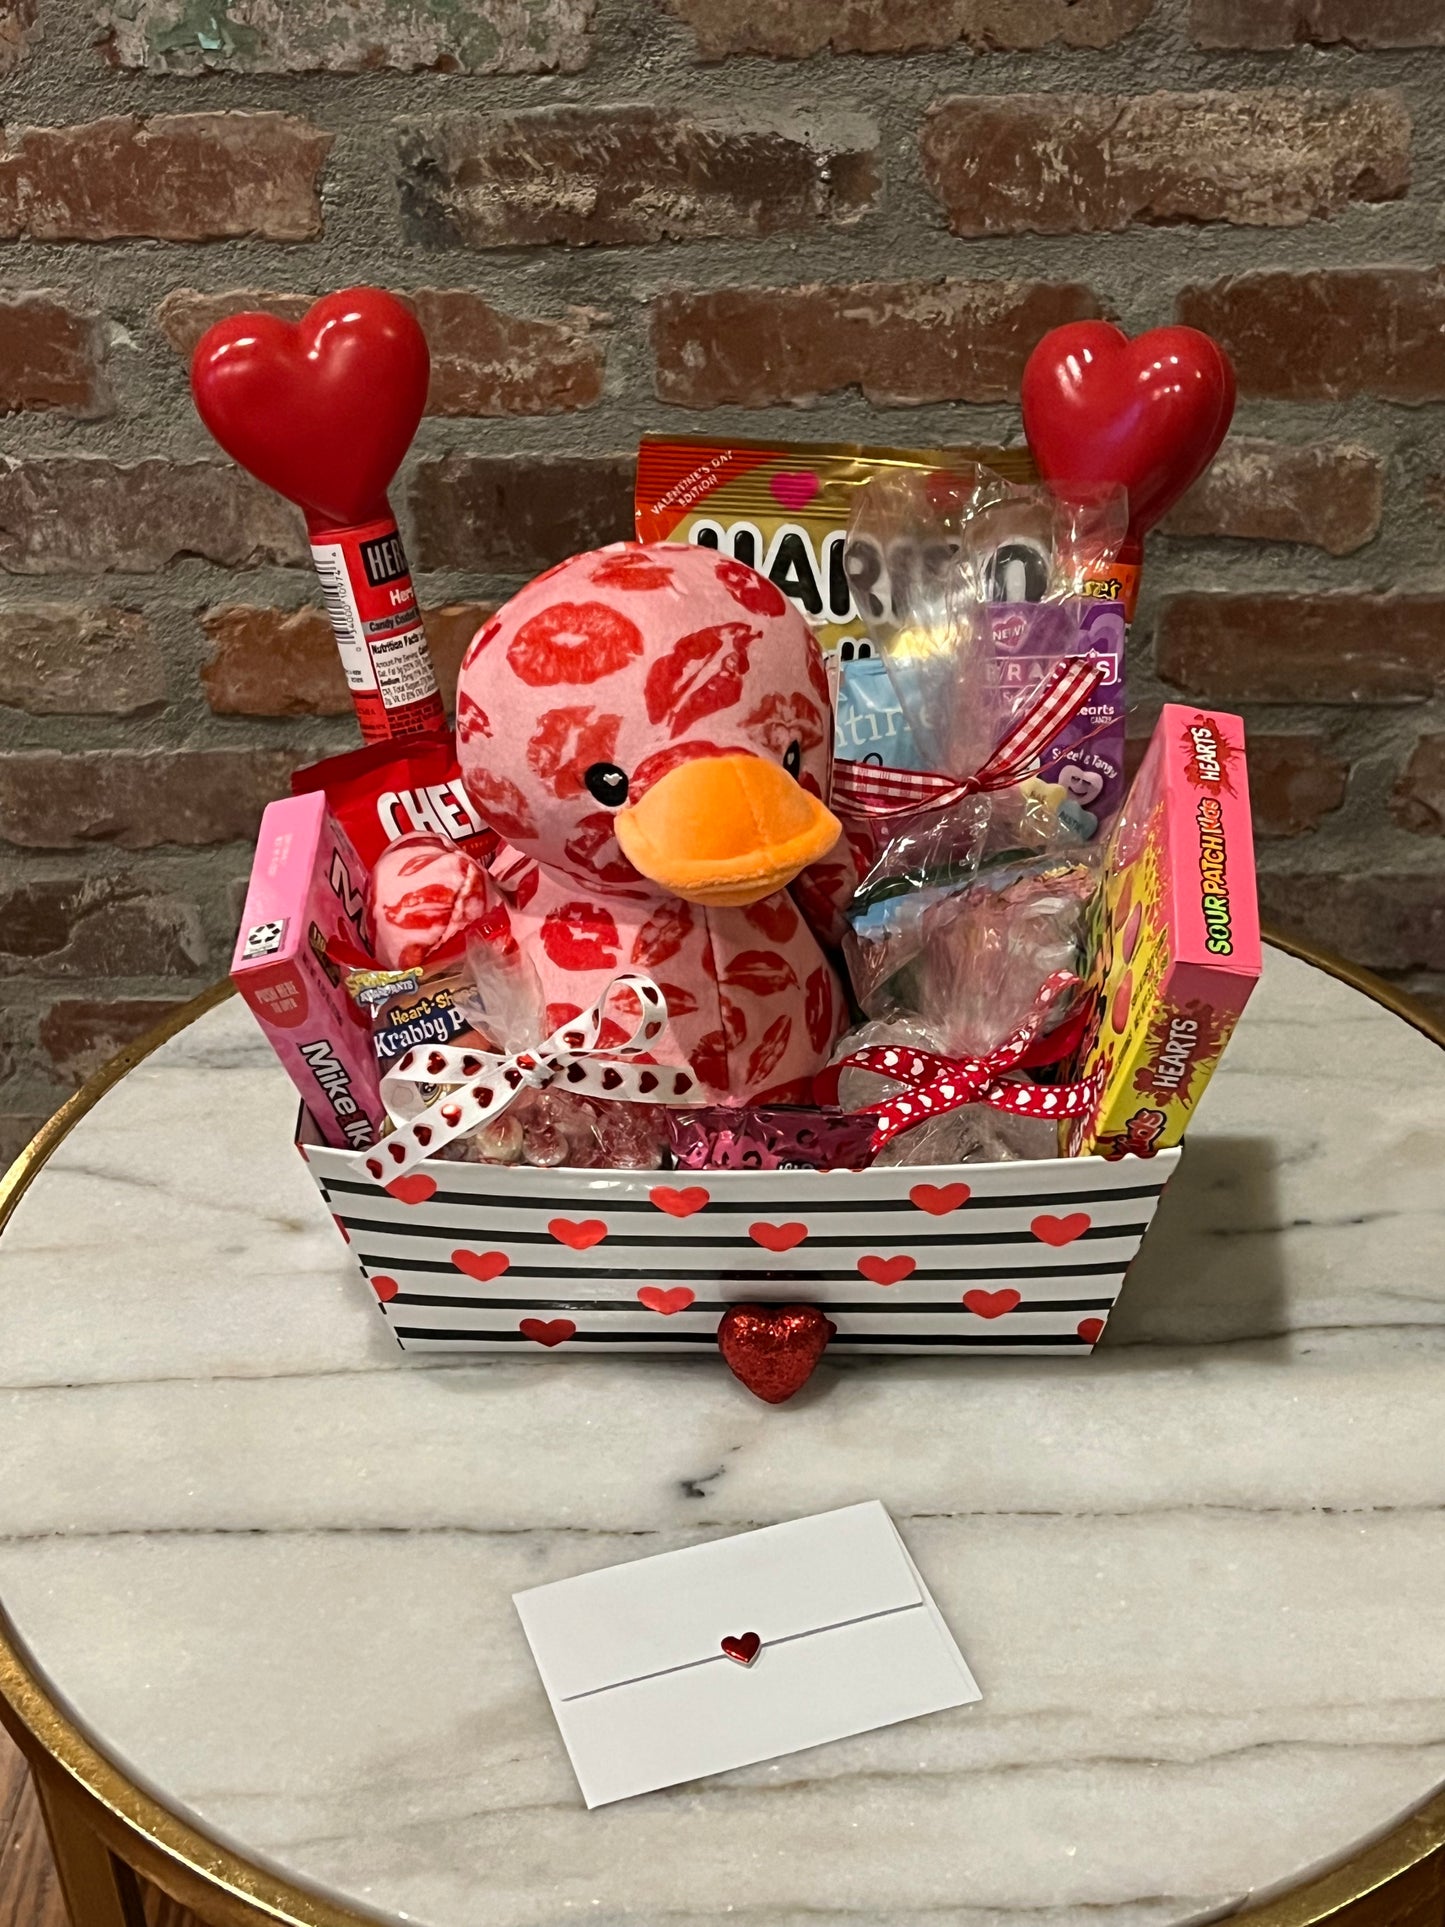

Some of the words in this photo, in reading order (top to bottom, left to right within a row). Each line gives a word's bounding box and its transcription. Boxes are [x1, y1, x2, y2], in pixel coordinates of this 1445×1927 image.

[650, 466, 711, 515] VALENTINE'S
[710, 450, 733, 468] DAY
[678, 474, 719, 507] EDITION
[367, 539, 406, 580] HER
[369, 618, 394, 632] Candy
[992, 625, 1025, 641] NEW!
[371, 640, 404, 655] Nutrition
[1077, 703, 1115, 717] earts
[1092, 754, 1118, 779] Tangy
[1190, 727, 1221, 781] HEARTS
[1197, 798, 1223, 836] Kids
[1200, 835, 1226, 896] PATCH
[1203, 895, 1232, 956] SOUR
[373, 1016, 449, 1058] Krabby
[1151, 1018, 1199, 1088] HEARTS
[301, 1040, 357, 1115] Mike
[343, 1118, 373, 1148] Ik
